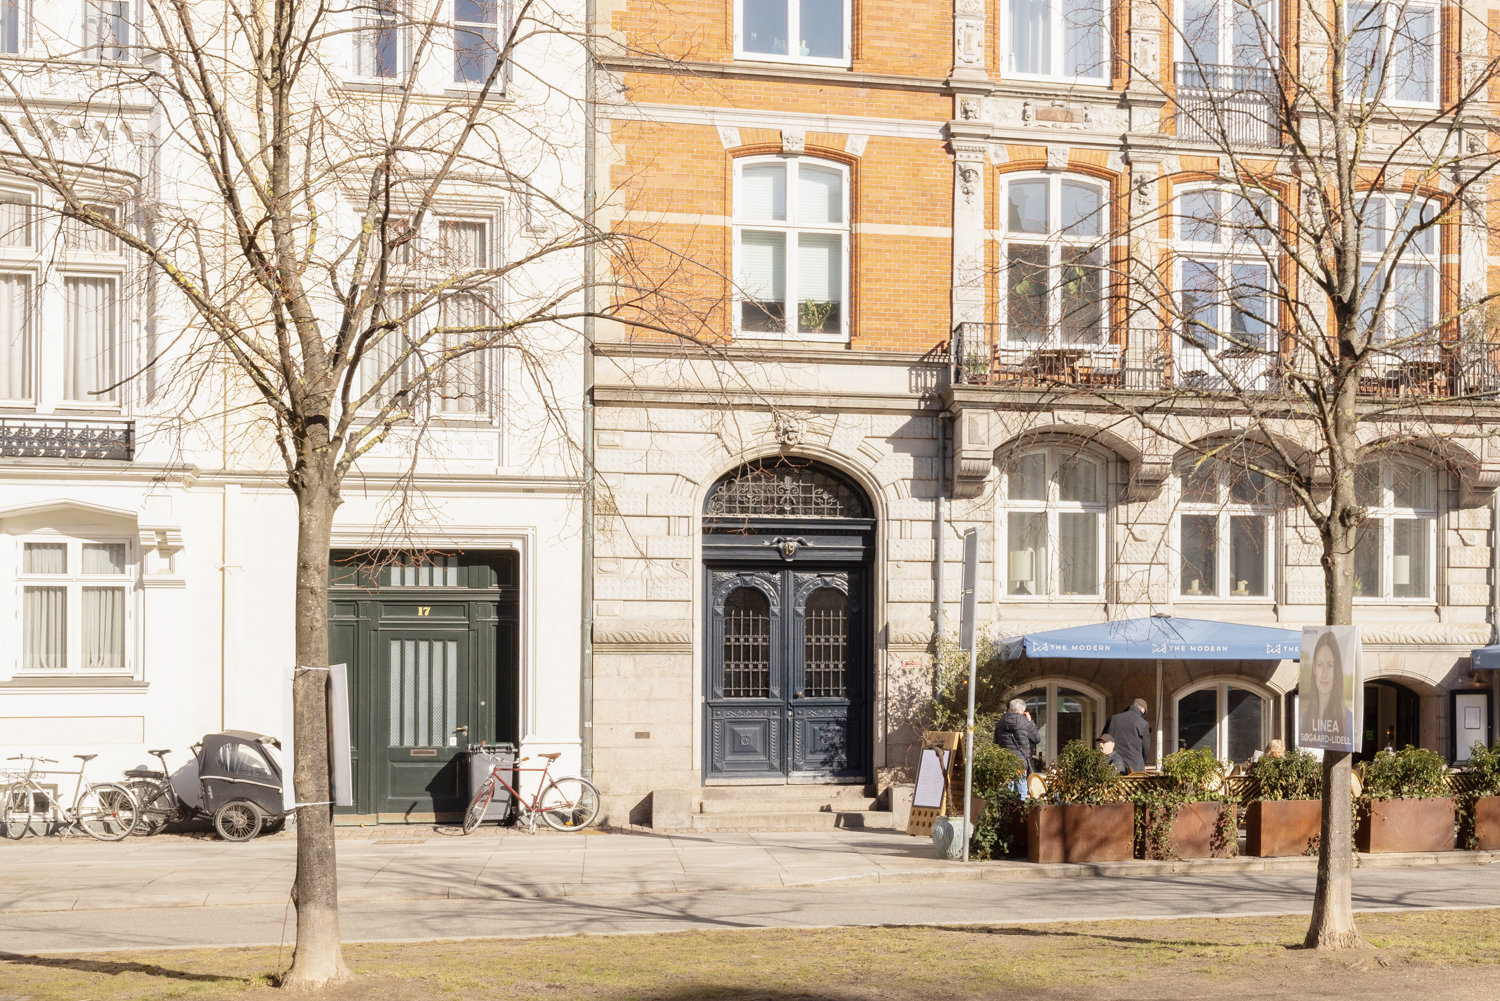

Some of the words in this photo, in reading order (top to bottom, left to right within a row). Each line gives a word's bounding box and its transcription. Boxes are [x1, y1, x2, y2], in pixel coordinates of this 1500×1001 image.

[785, 543, 795, 556] 19
[417, 606, 431, 616] 17
[1312, 718, 1340, 733] LINEA
[1300, 732, 1352, 745] SØGAARD-LIDELL
